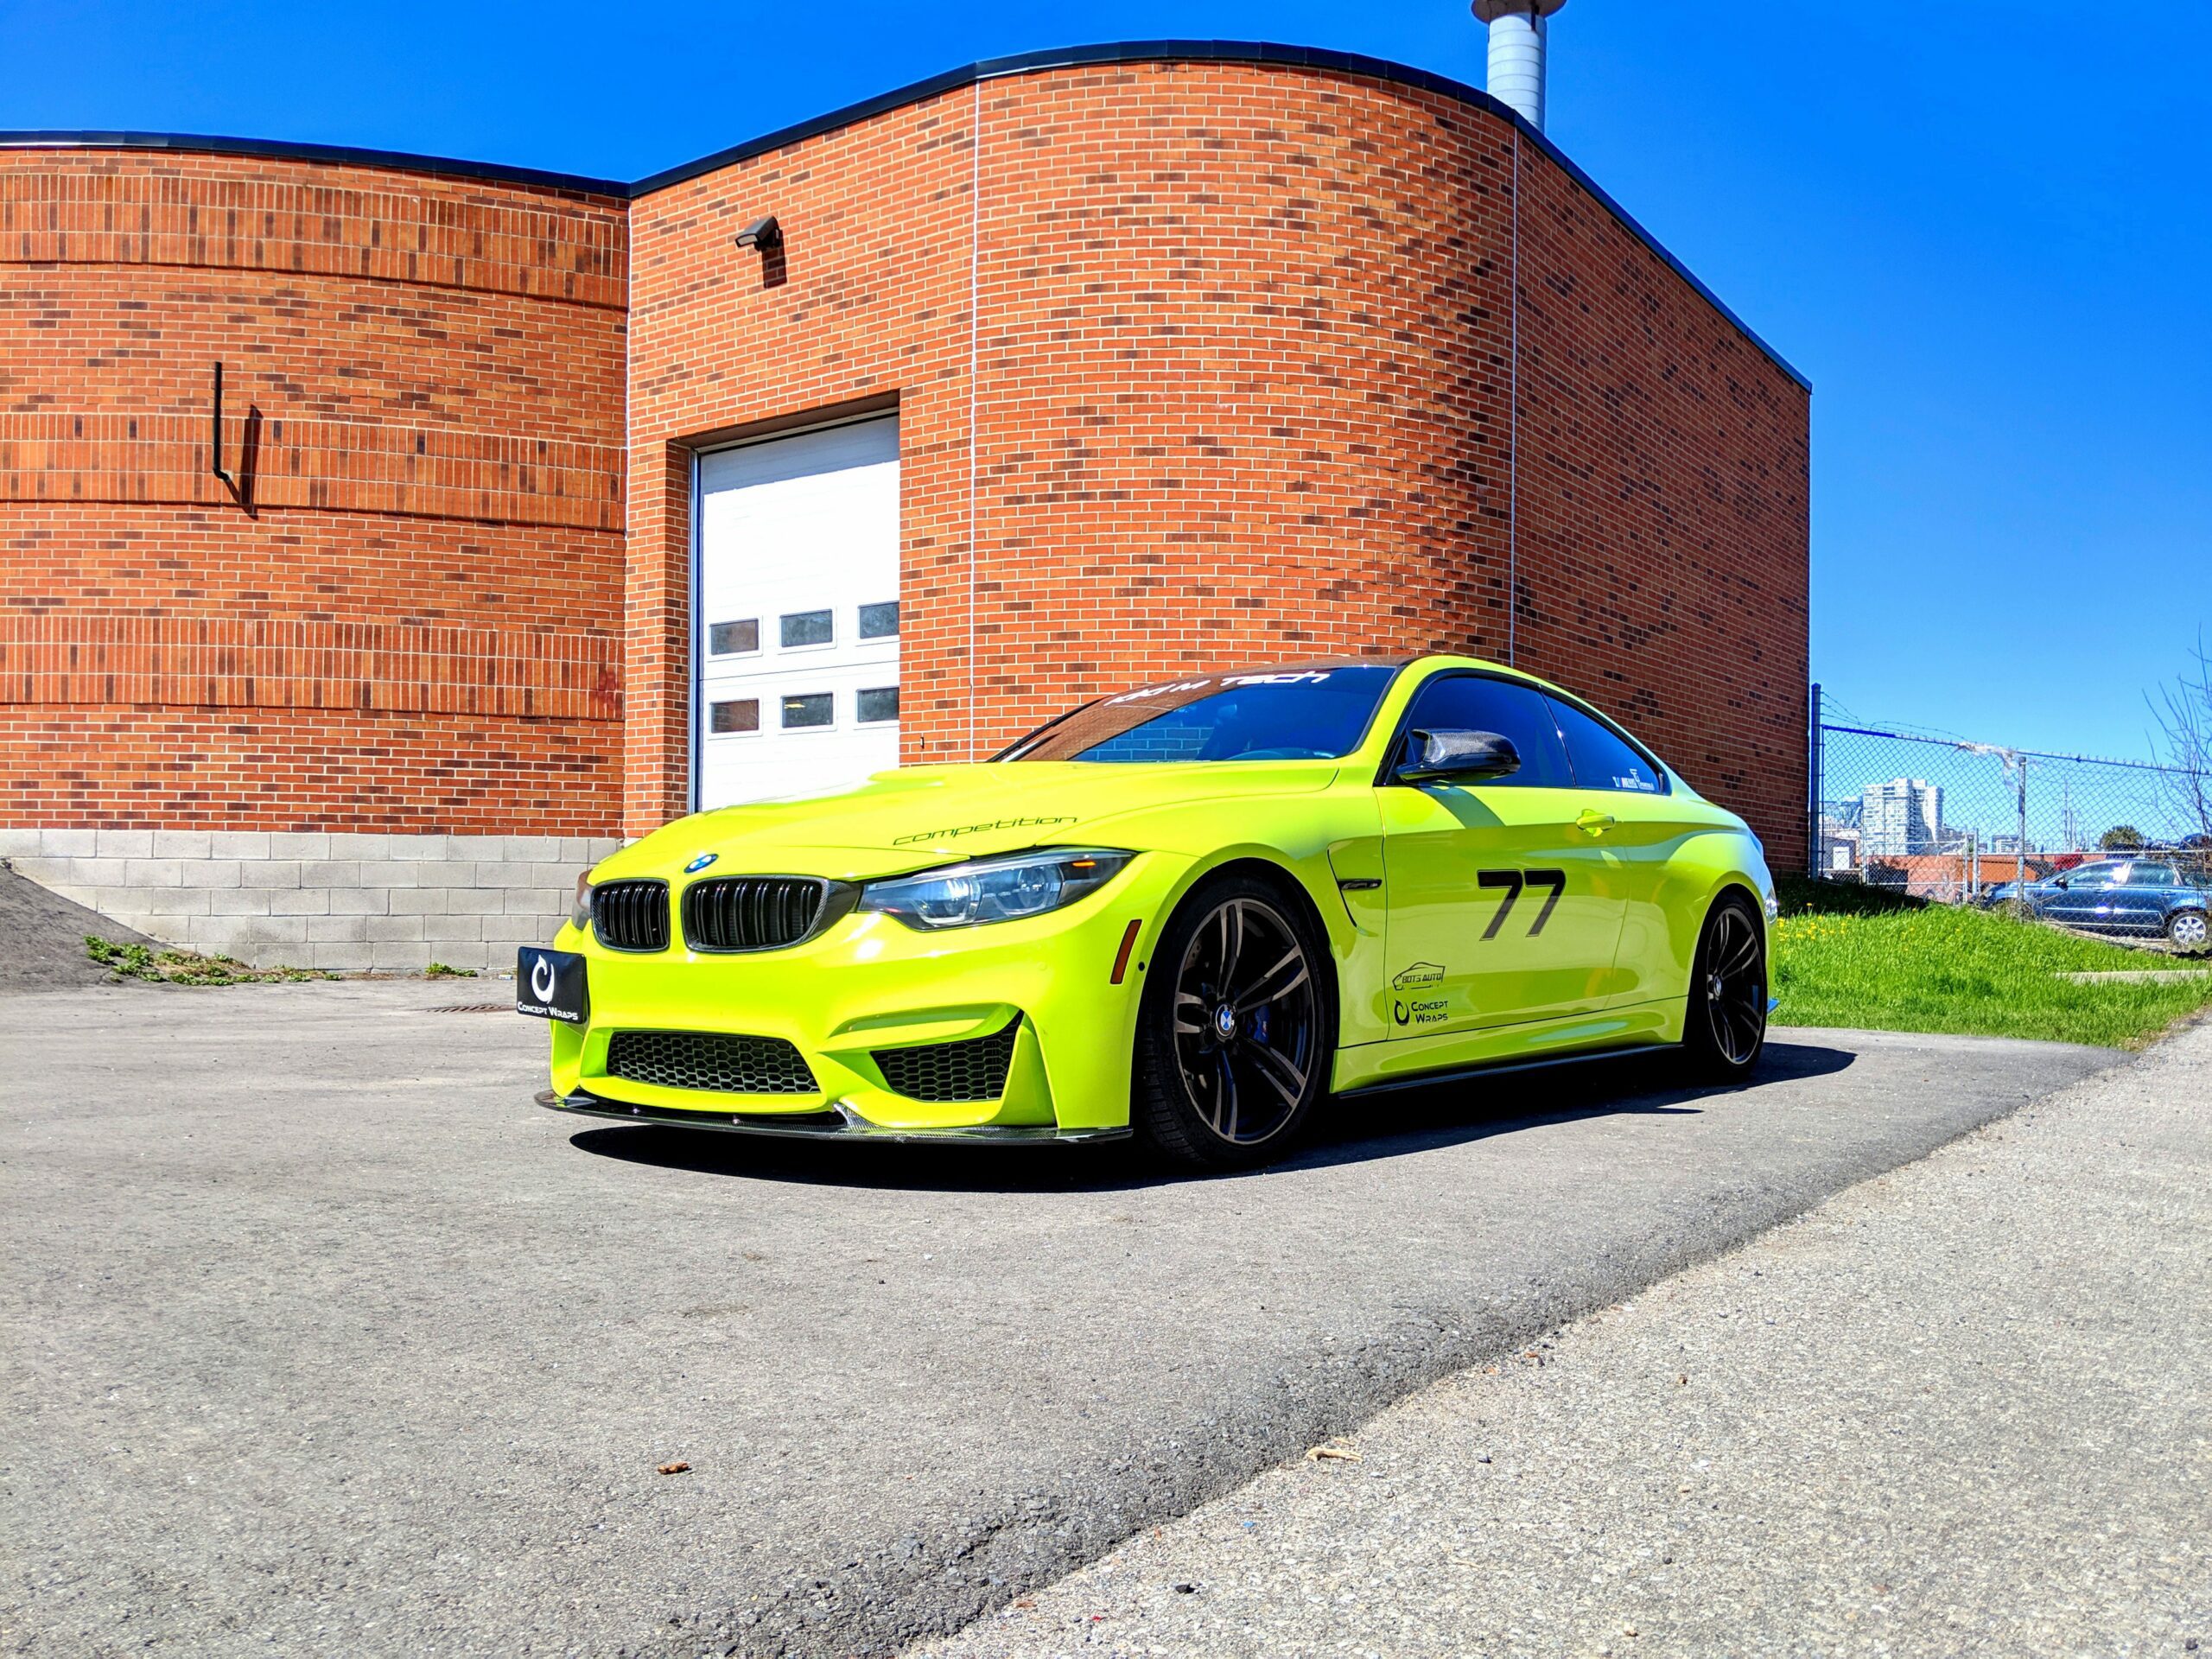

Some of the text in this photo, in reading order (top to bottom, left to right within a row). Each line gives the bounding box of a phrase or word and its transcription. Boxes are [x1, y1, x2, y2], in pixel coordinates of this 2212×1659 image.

[893, 817, 1078, 846] competition
[1477, 868, 1567, 942] 77
[1422, 973, 1442, 982] AUTO
[518, 1001, 579, 1020] CONCEPT WRAPS
[1411, 1001, 1449, 1012] CONCEPT
[1415, 1014, 1449, 1024] WRAPS
